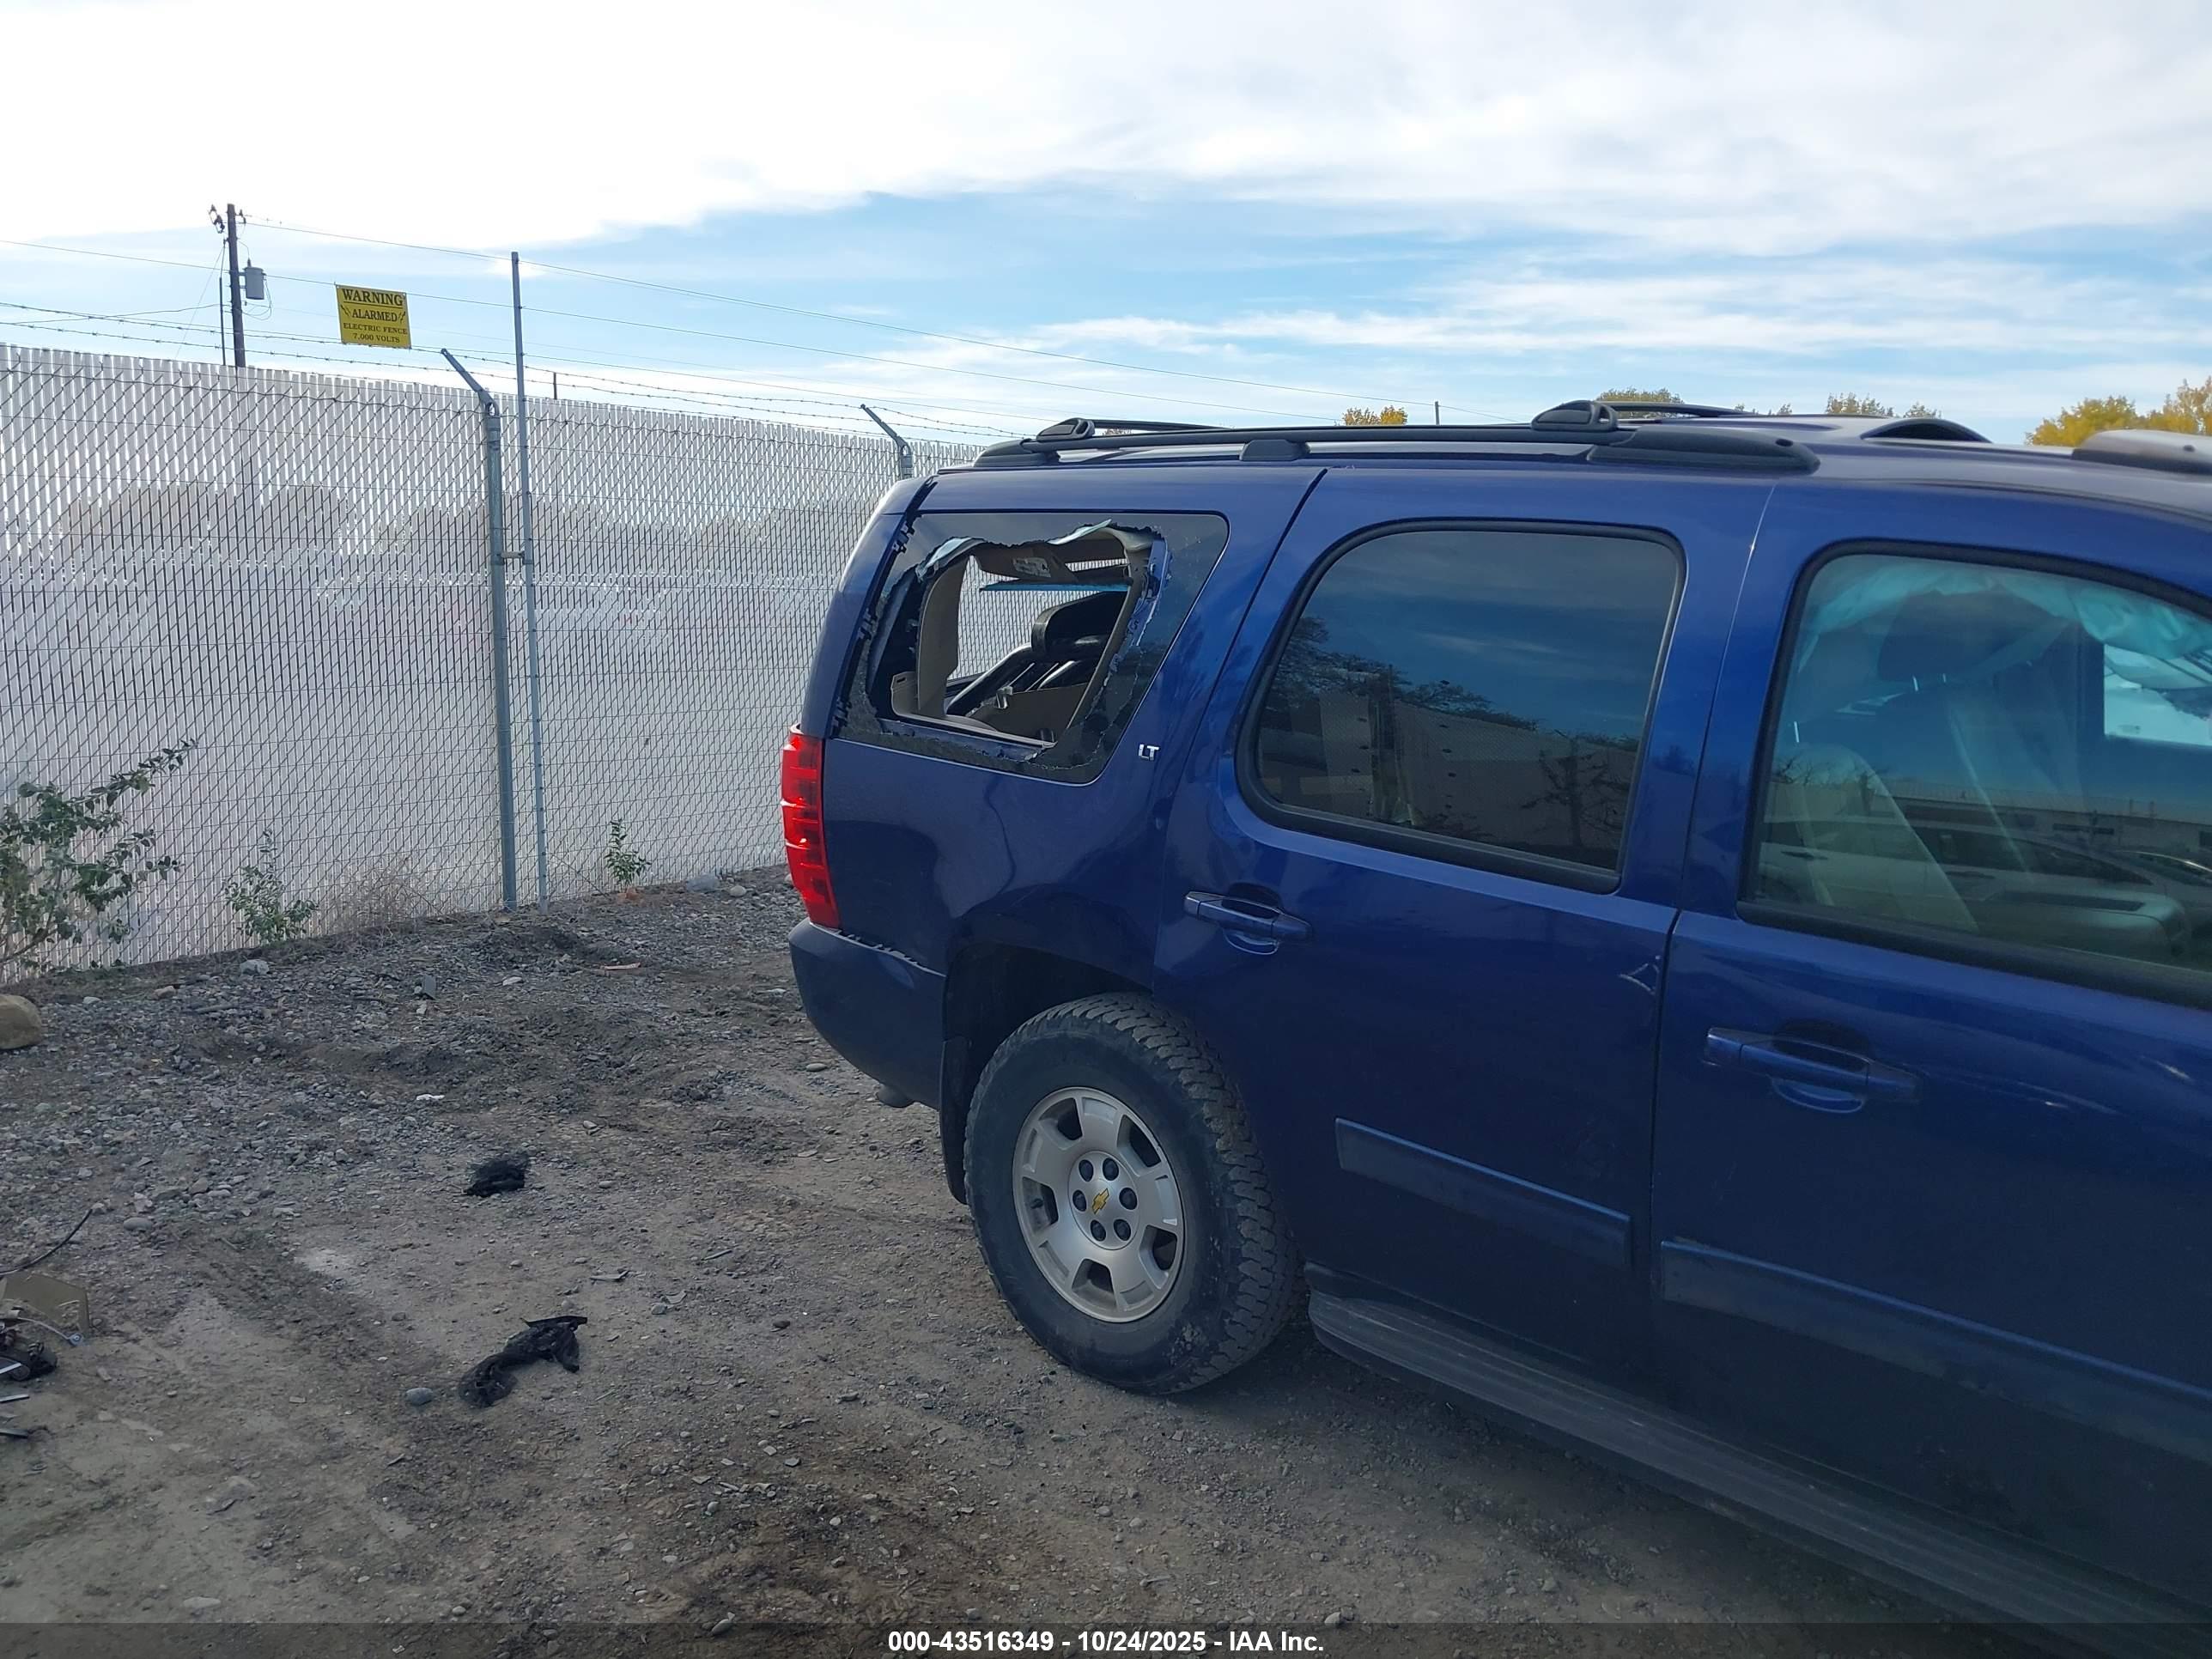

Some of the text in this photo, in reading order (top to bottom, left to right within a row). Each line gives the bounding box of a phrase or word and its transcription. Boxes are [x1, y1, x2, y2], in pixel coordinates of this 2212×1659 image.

[342, 289, 404, 306] WARNING
[352, 309, 398, 322] ALARMED
[343, 322, 408, 335] ELECTRIC FENCE
[1139, 744, 1159, 761] LT
